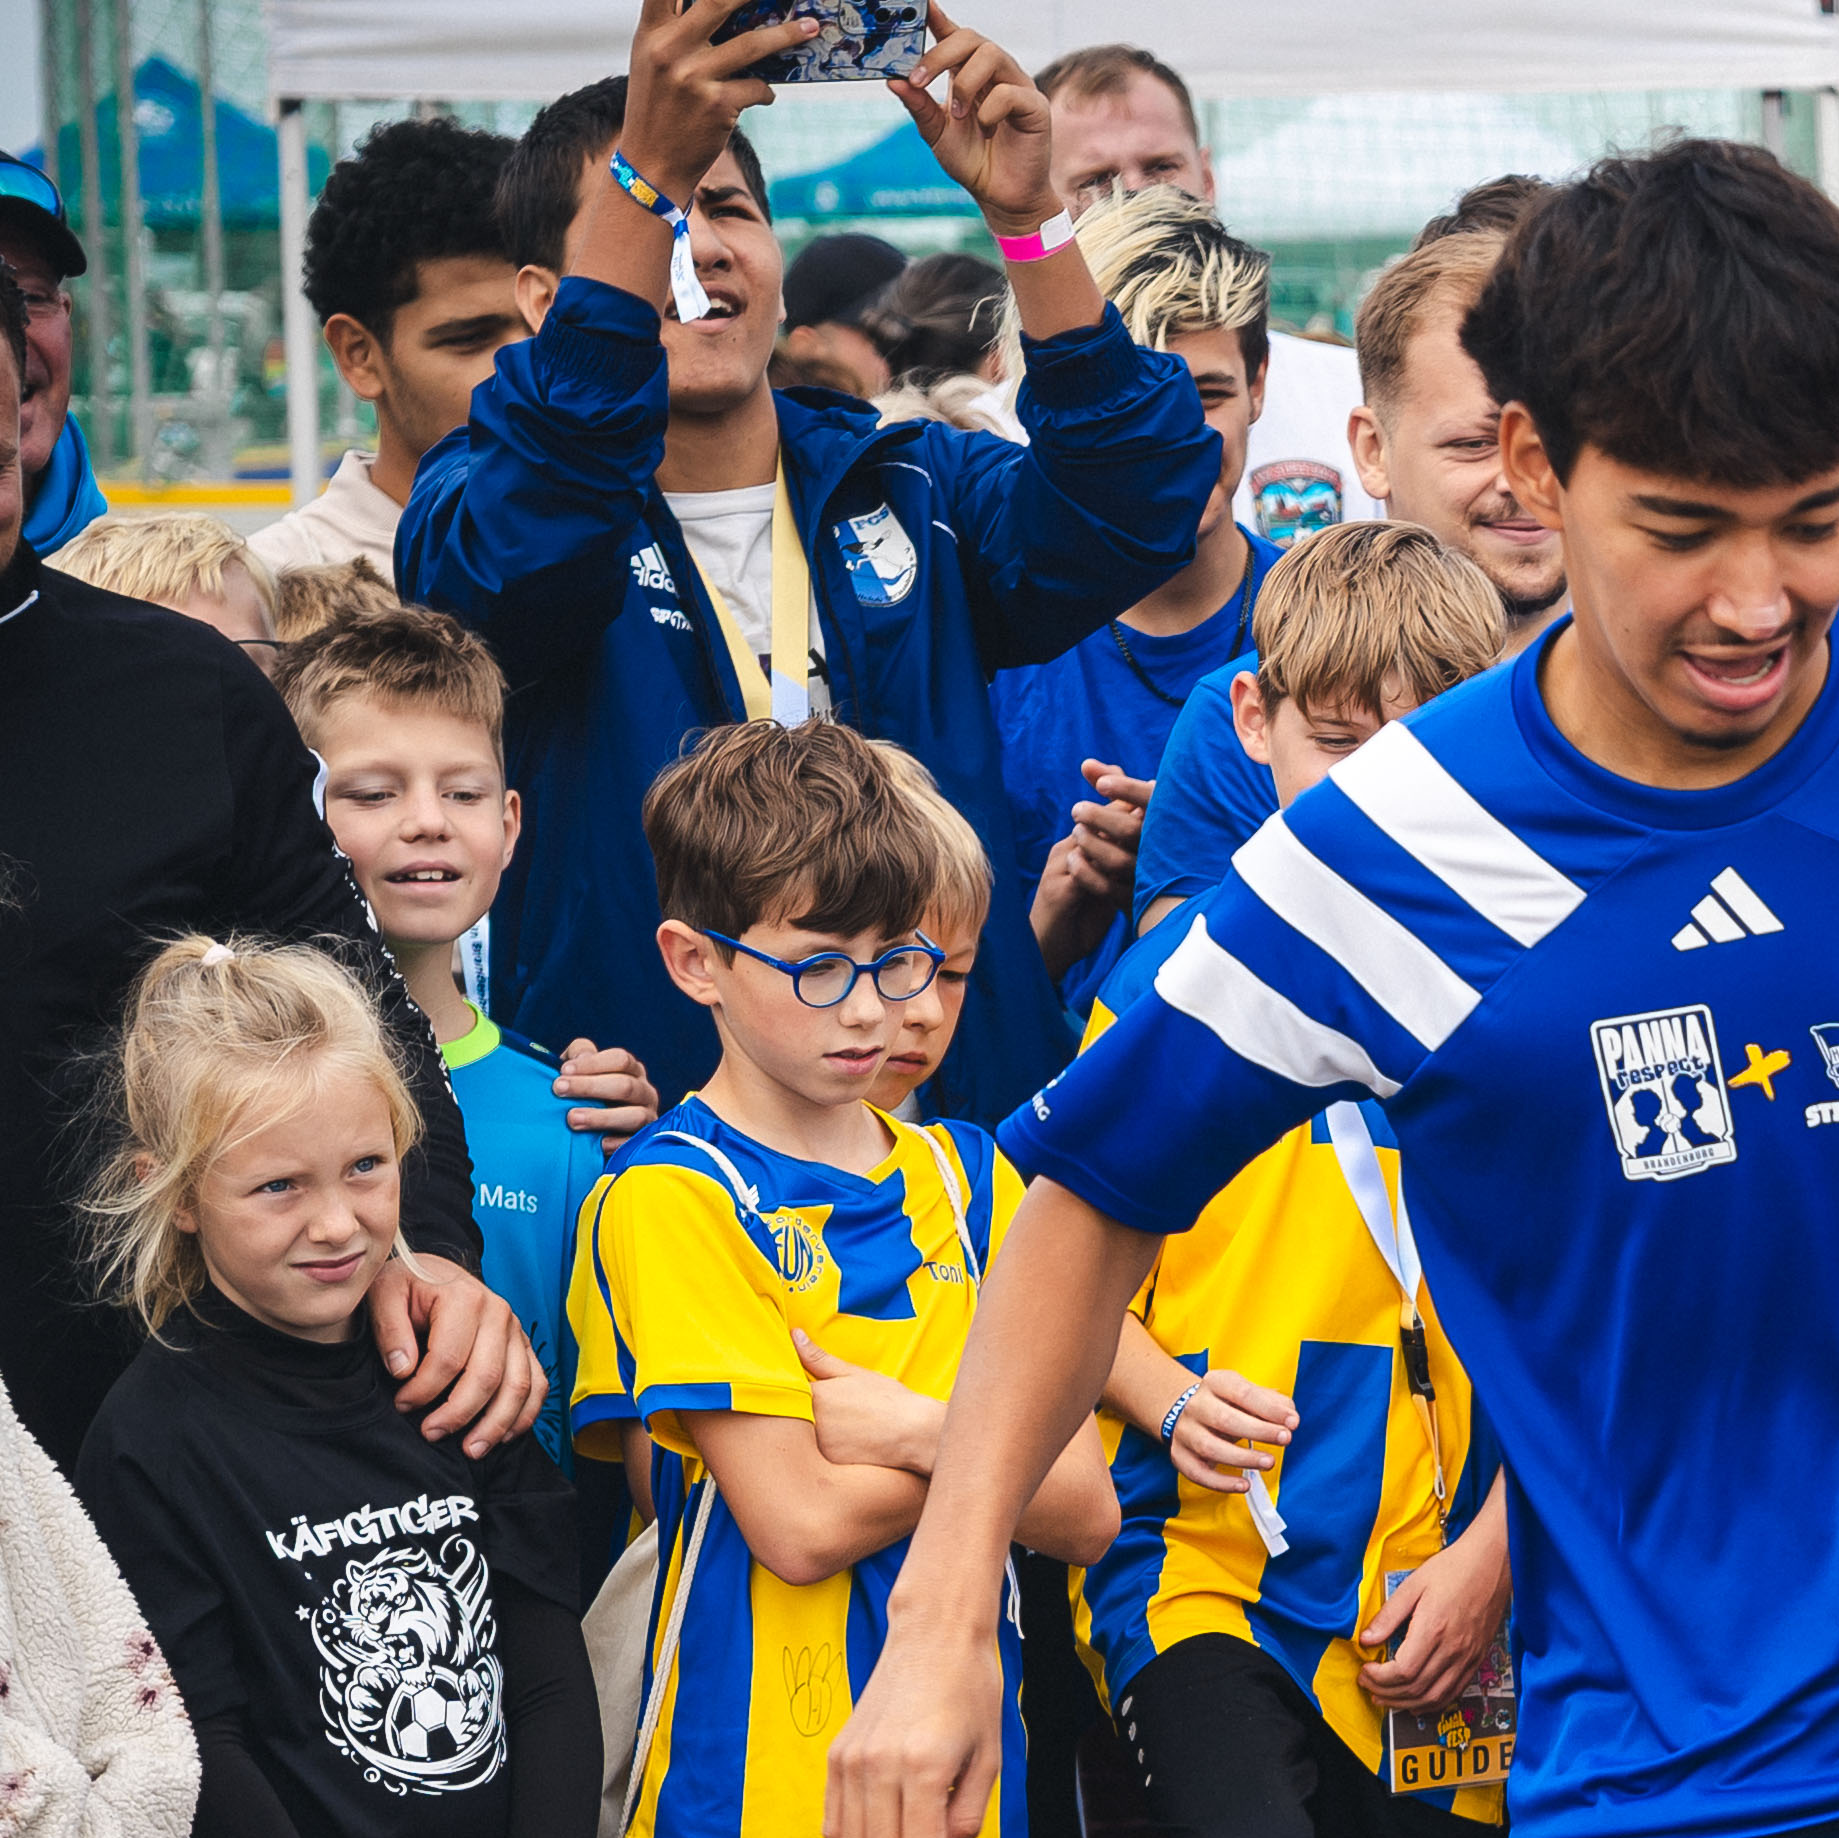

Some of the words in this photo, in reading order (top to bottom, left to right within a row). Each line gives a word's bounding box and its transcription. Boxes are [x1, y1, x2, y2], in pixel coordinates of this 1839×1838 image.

[1600, 1014, 1711, 1080] PANNA
[1617, 1055, 1704, 1088] respect
[1644, 1147, 1715, 1170] BRANDENBURG
[480, 1184, 538, 1214] Mats
[923, 1261, 965, 1284] Toni
[265, 1493, 480, 1562] KÄFIGTIGER
[1401, 1740, 1513, 1785] GUIDE
